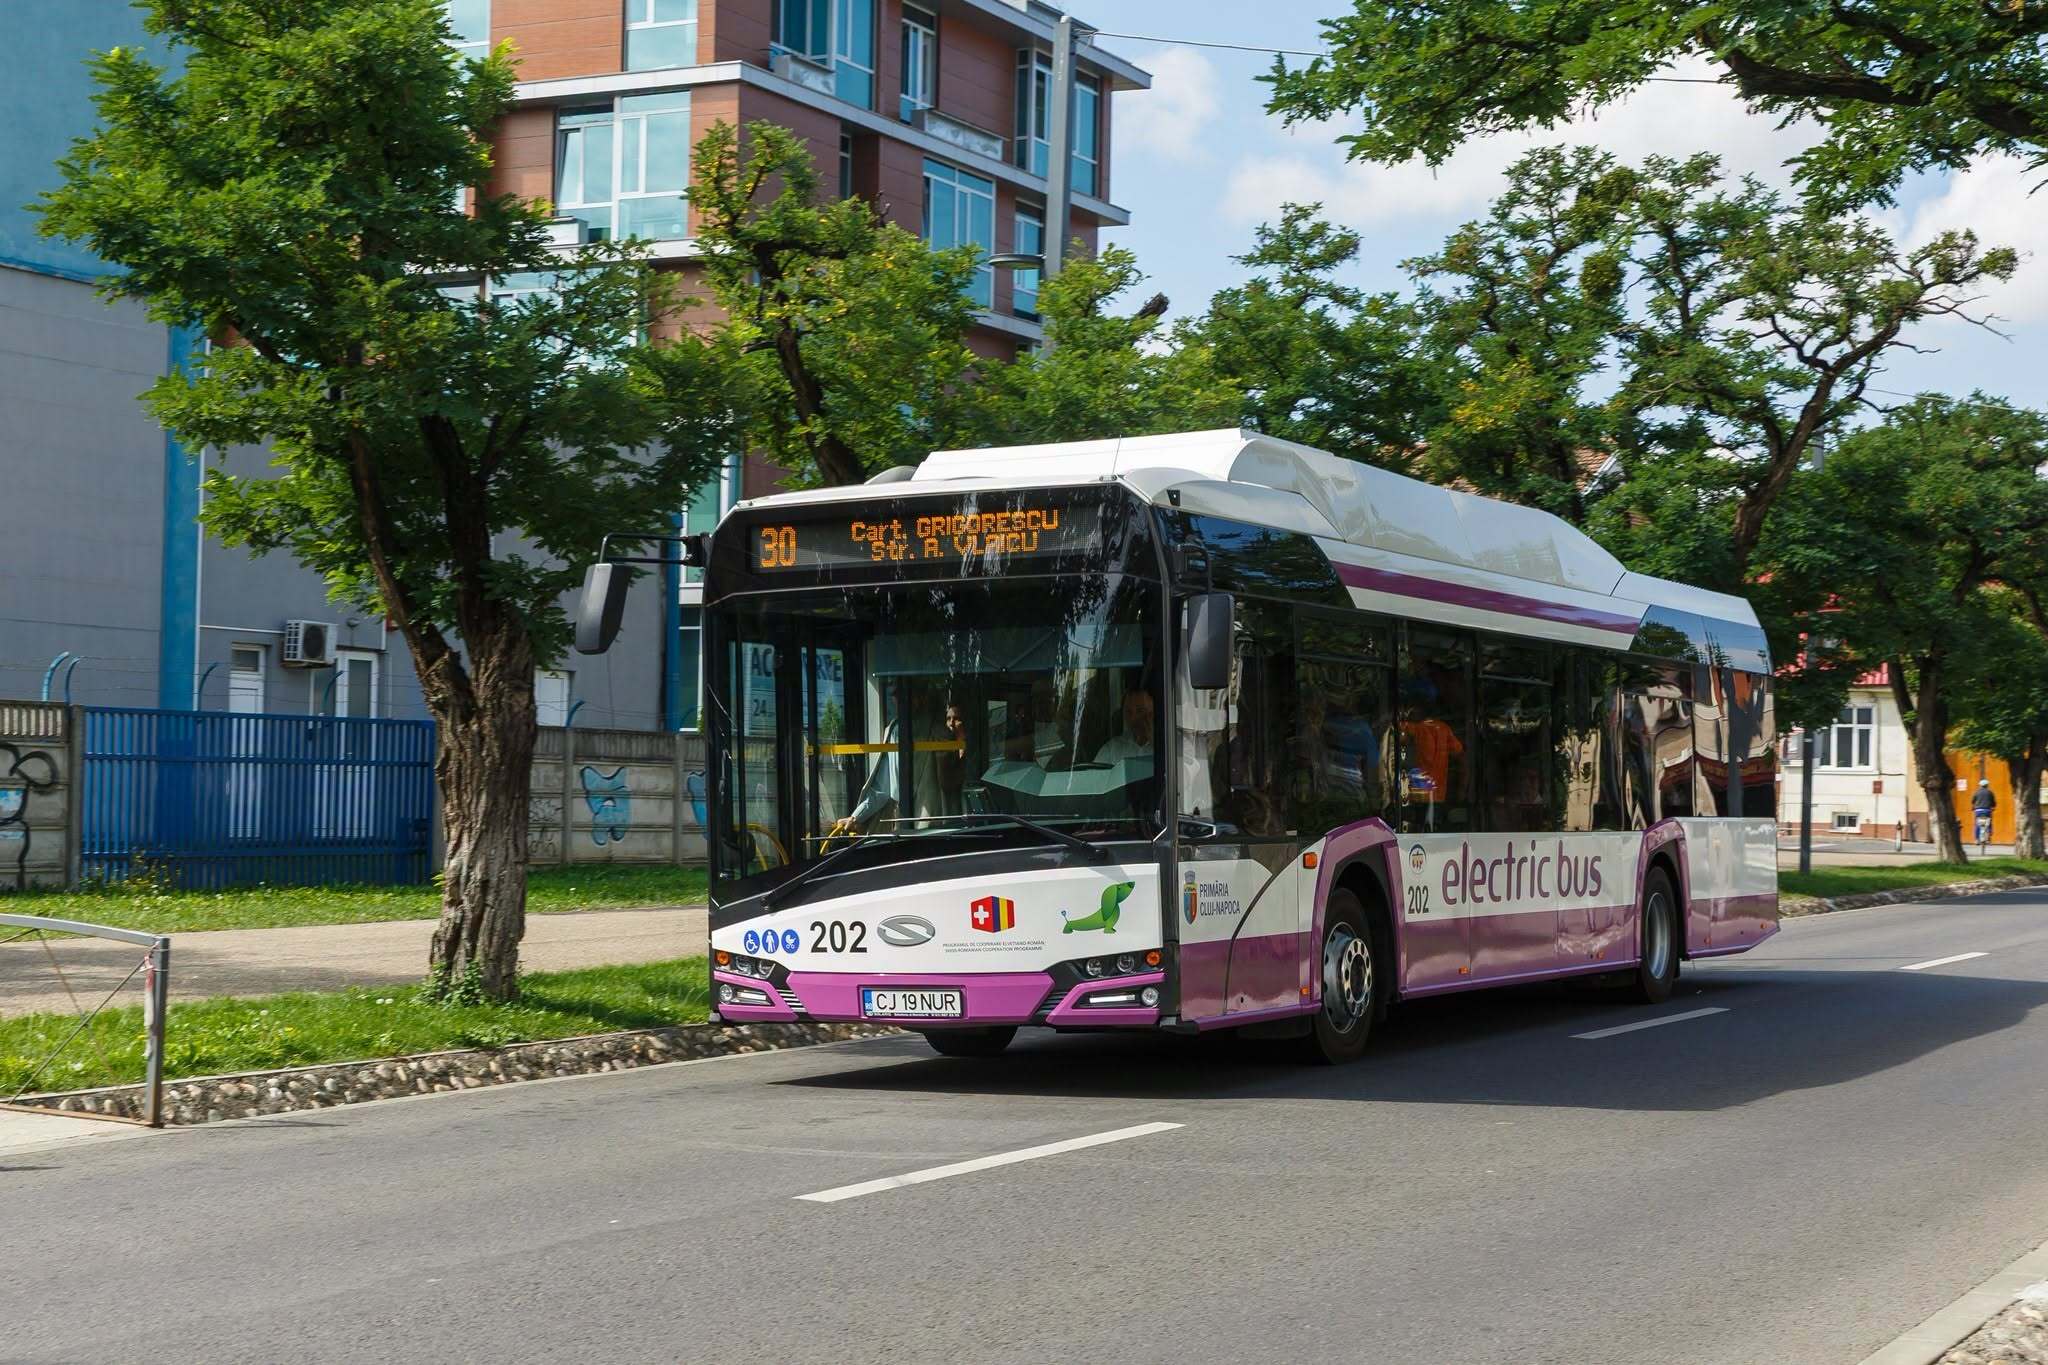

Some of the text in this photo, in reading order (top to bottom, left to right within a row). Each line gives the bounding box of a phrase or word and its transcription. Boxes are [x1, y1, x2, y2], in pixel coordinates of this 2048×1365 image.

[851, 509, 1059, 542] Cart. GRIGORESCU
[761, 526, 797, 568] 30
[871, 531, 1038, 561] Str. A. VLAICU
[1442, 839, 1602, 905] electric bus
[1199, 900, 1240, 916] CLUJ-NAPOCA
[1407, 885, 1430, 915] 202
[810, 920, 868, 953] 202
[876, 993, 956, 1010] CJ 19 NUR
